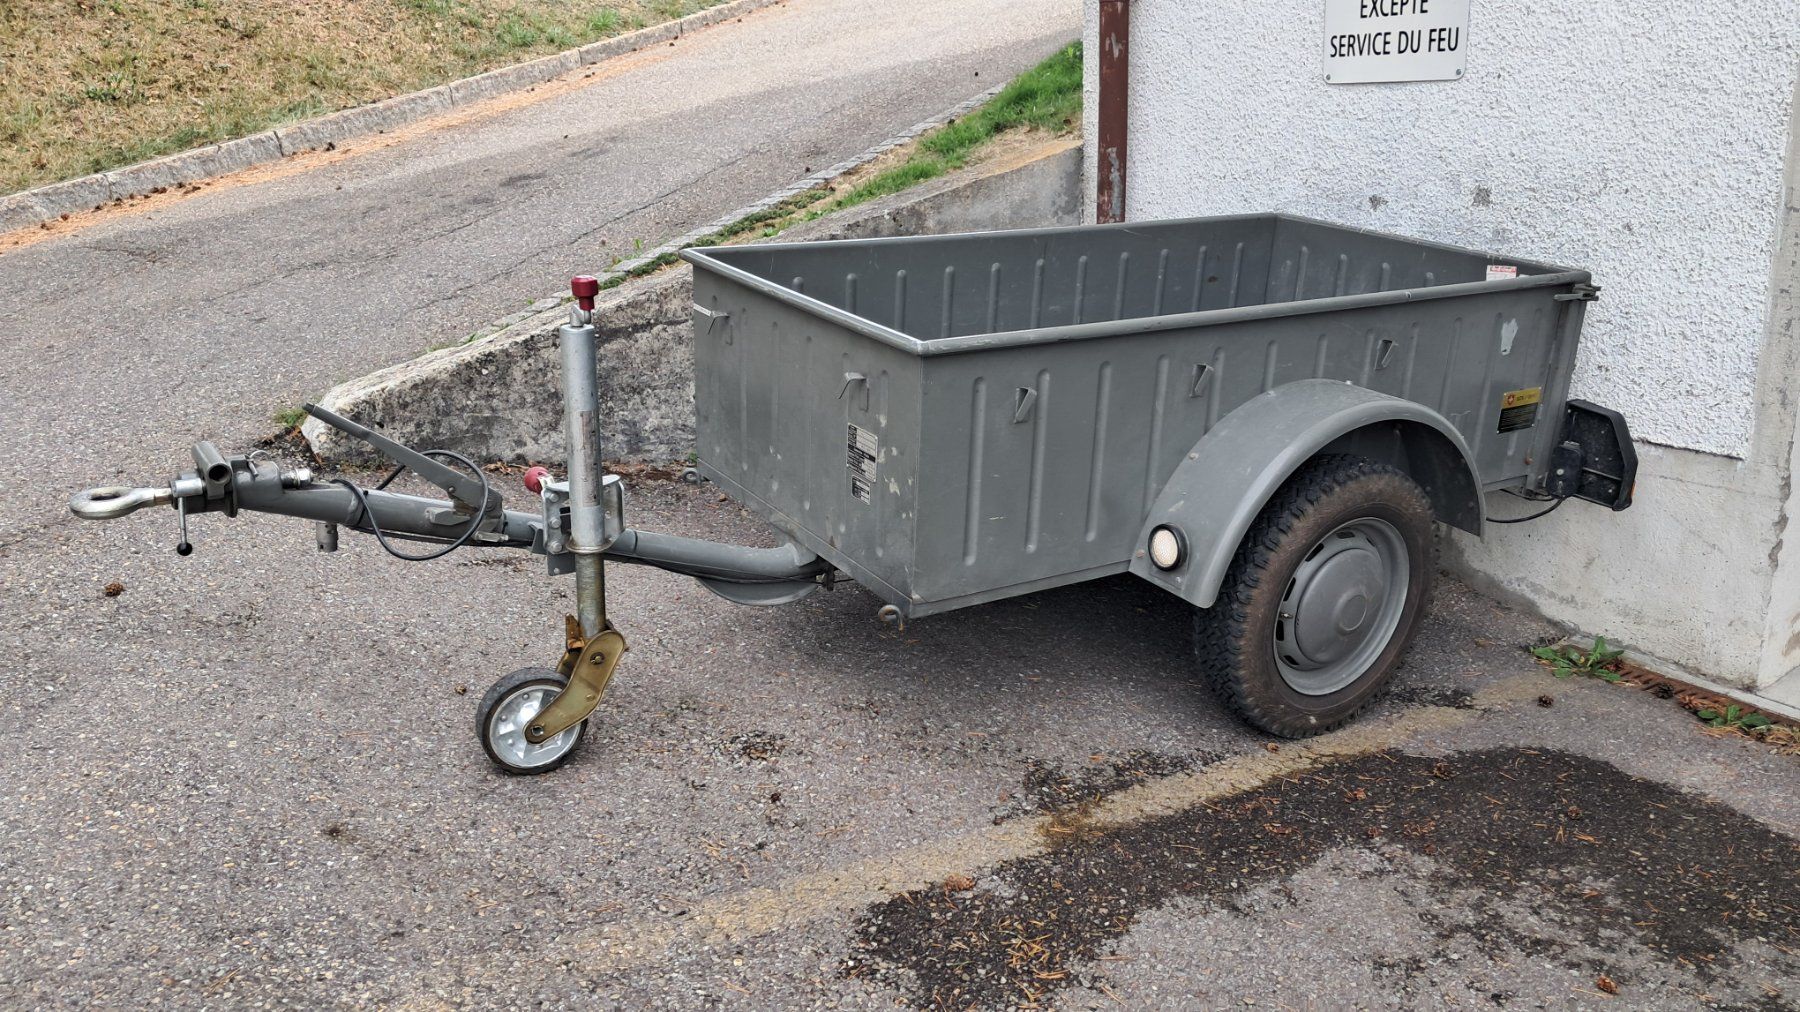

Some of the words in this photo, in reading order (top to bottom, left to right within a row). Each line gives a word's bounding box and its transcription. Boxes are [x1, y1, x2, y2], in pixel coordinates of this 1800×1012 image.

[1330, 32, 1391, 57] SERVICE
[1398, 30, 1421, 54] DU
[1428, 27, 1459, 52] FEU
